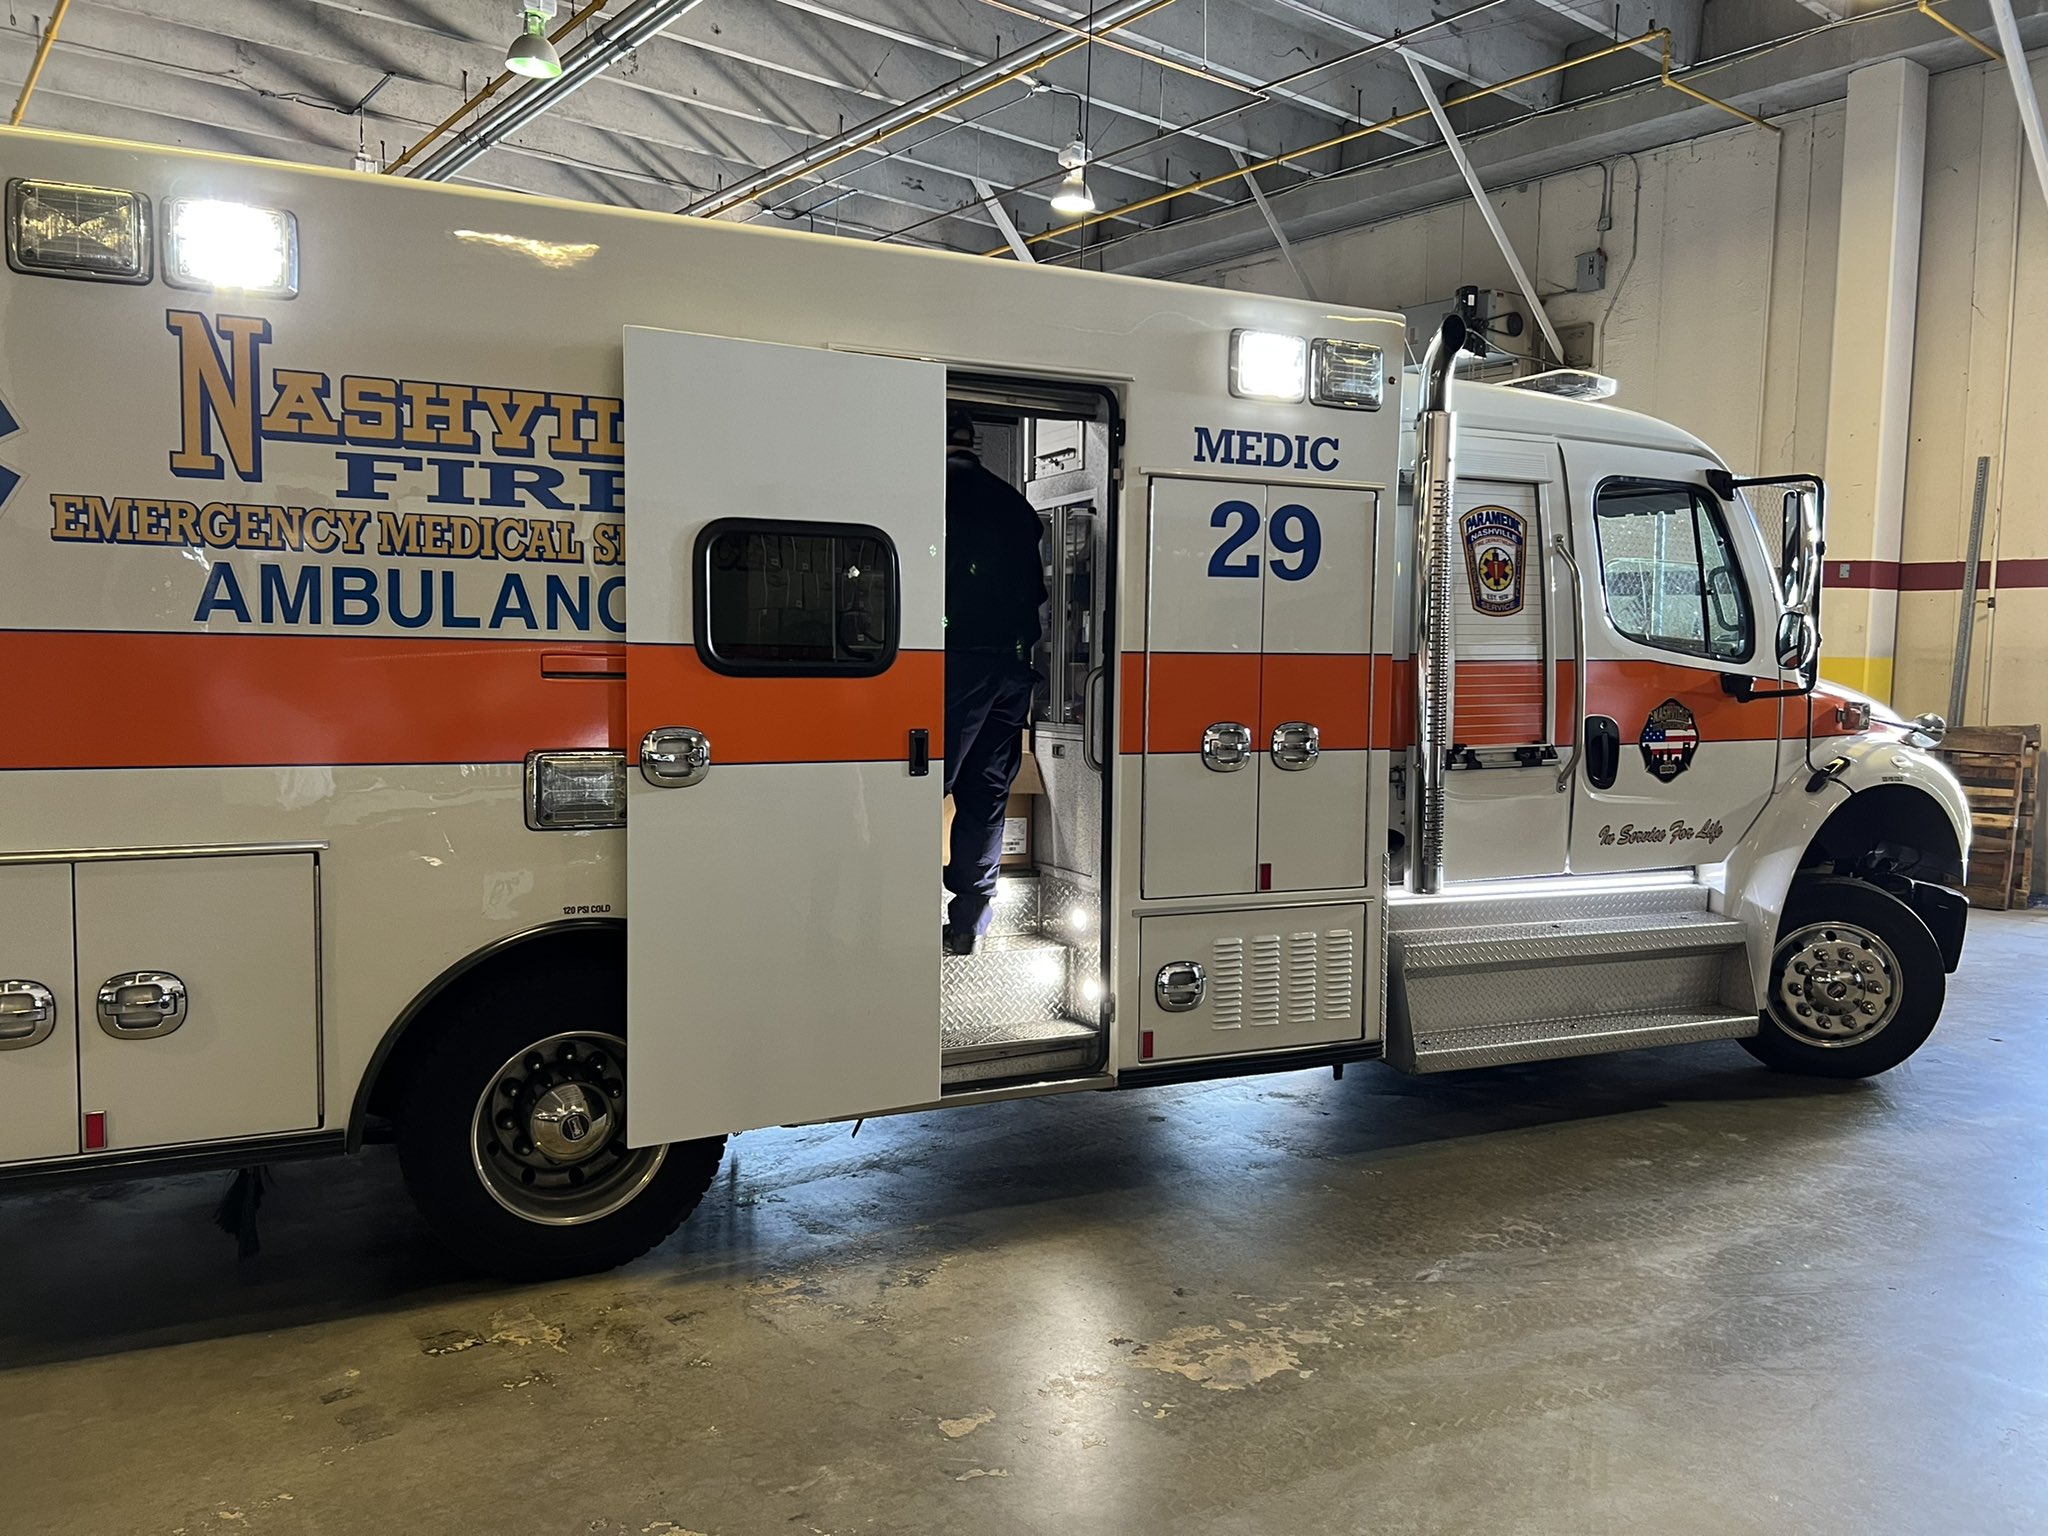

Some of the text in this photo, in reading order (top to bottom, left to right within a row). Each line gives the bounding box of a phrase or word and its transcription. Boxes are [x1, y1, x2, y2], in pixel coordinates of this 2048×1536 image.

[1194, 427, 1339, 471] MEDIC
[336, 452, 624, 513] FIRE
[50, 494, 370, 554] EMERGENCY
[377, 511, 583, 564] MEDICAL
[1465, 511, 1521, 537] PARAMEDIC
[1471, 528, 1518, 543] NASHVILLE
[1208, 500, 1321, 581] 29
[1481, 601, 1516, 612] SERVICE
[1599, 818, 1723, 846] In Service For Life
[563, 904, 611, 915] 120 PSI COLD
